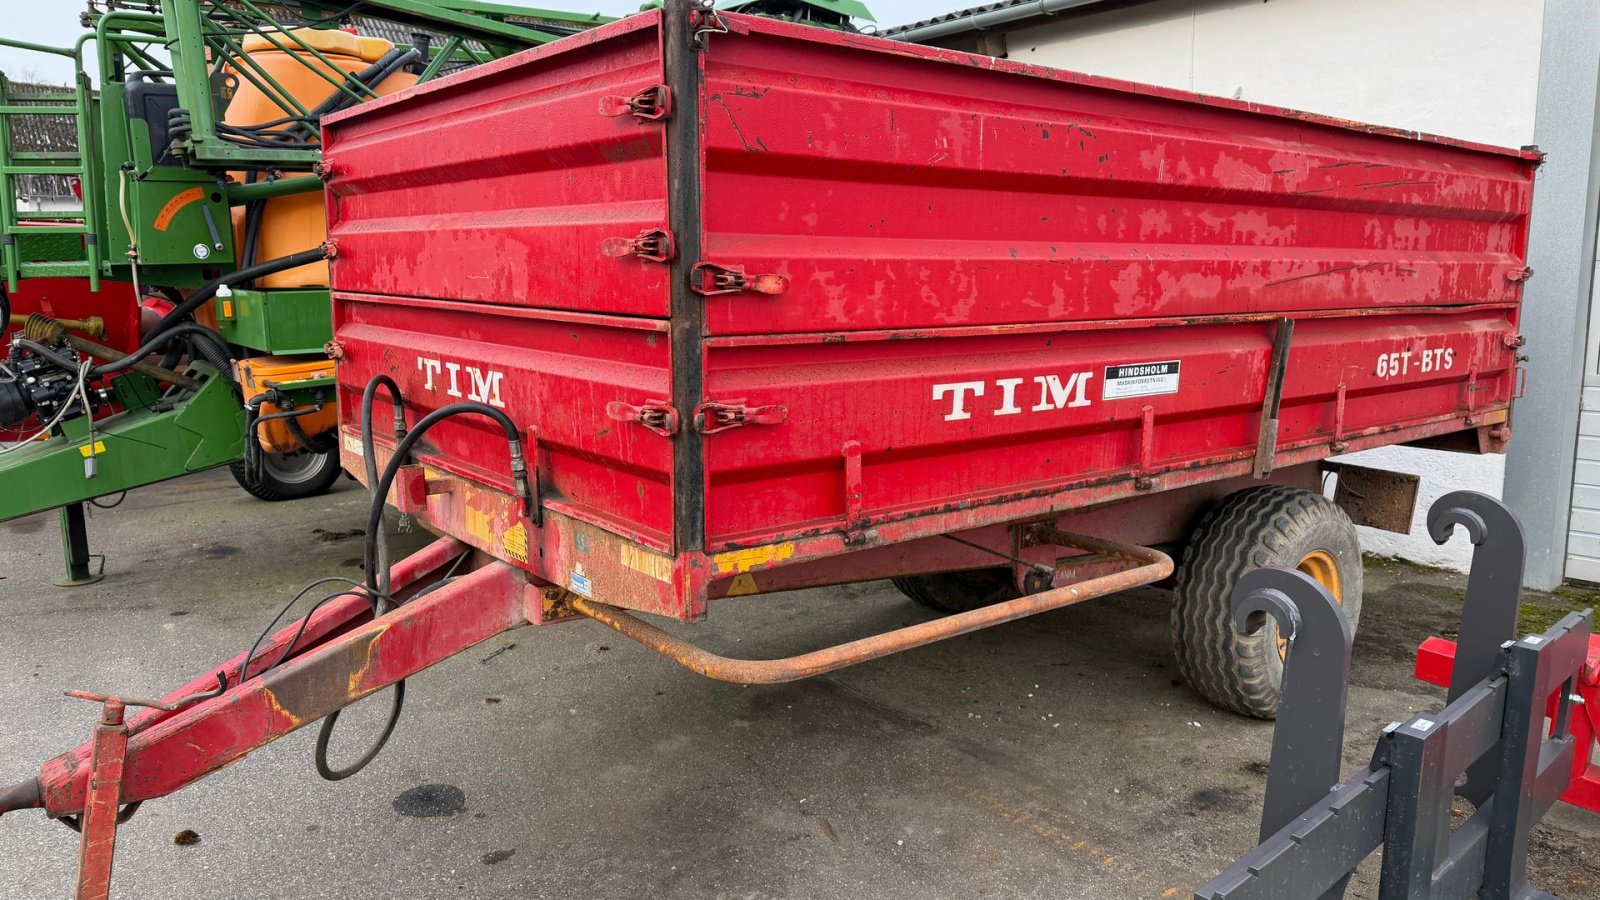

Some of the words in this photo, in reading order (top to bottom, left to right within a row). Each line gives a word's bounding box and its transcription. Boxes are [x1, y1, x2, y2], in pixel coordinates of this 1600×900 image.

[417, 356, 506, 408] TIM
[1118, 364, 1169, 377] HINDSHOLM
[1376, 347, 1454, 378] 65T-BTS
[932, 371, 1094, 422] TIM
